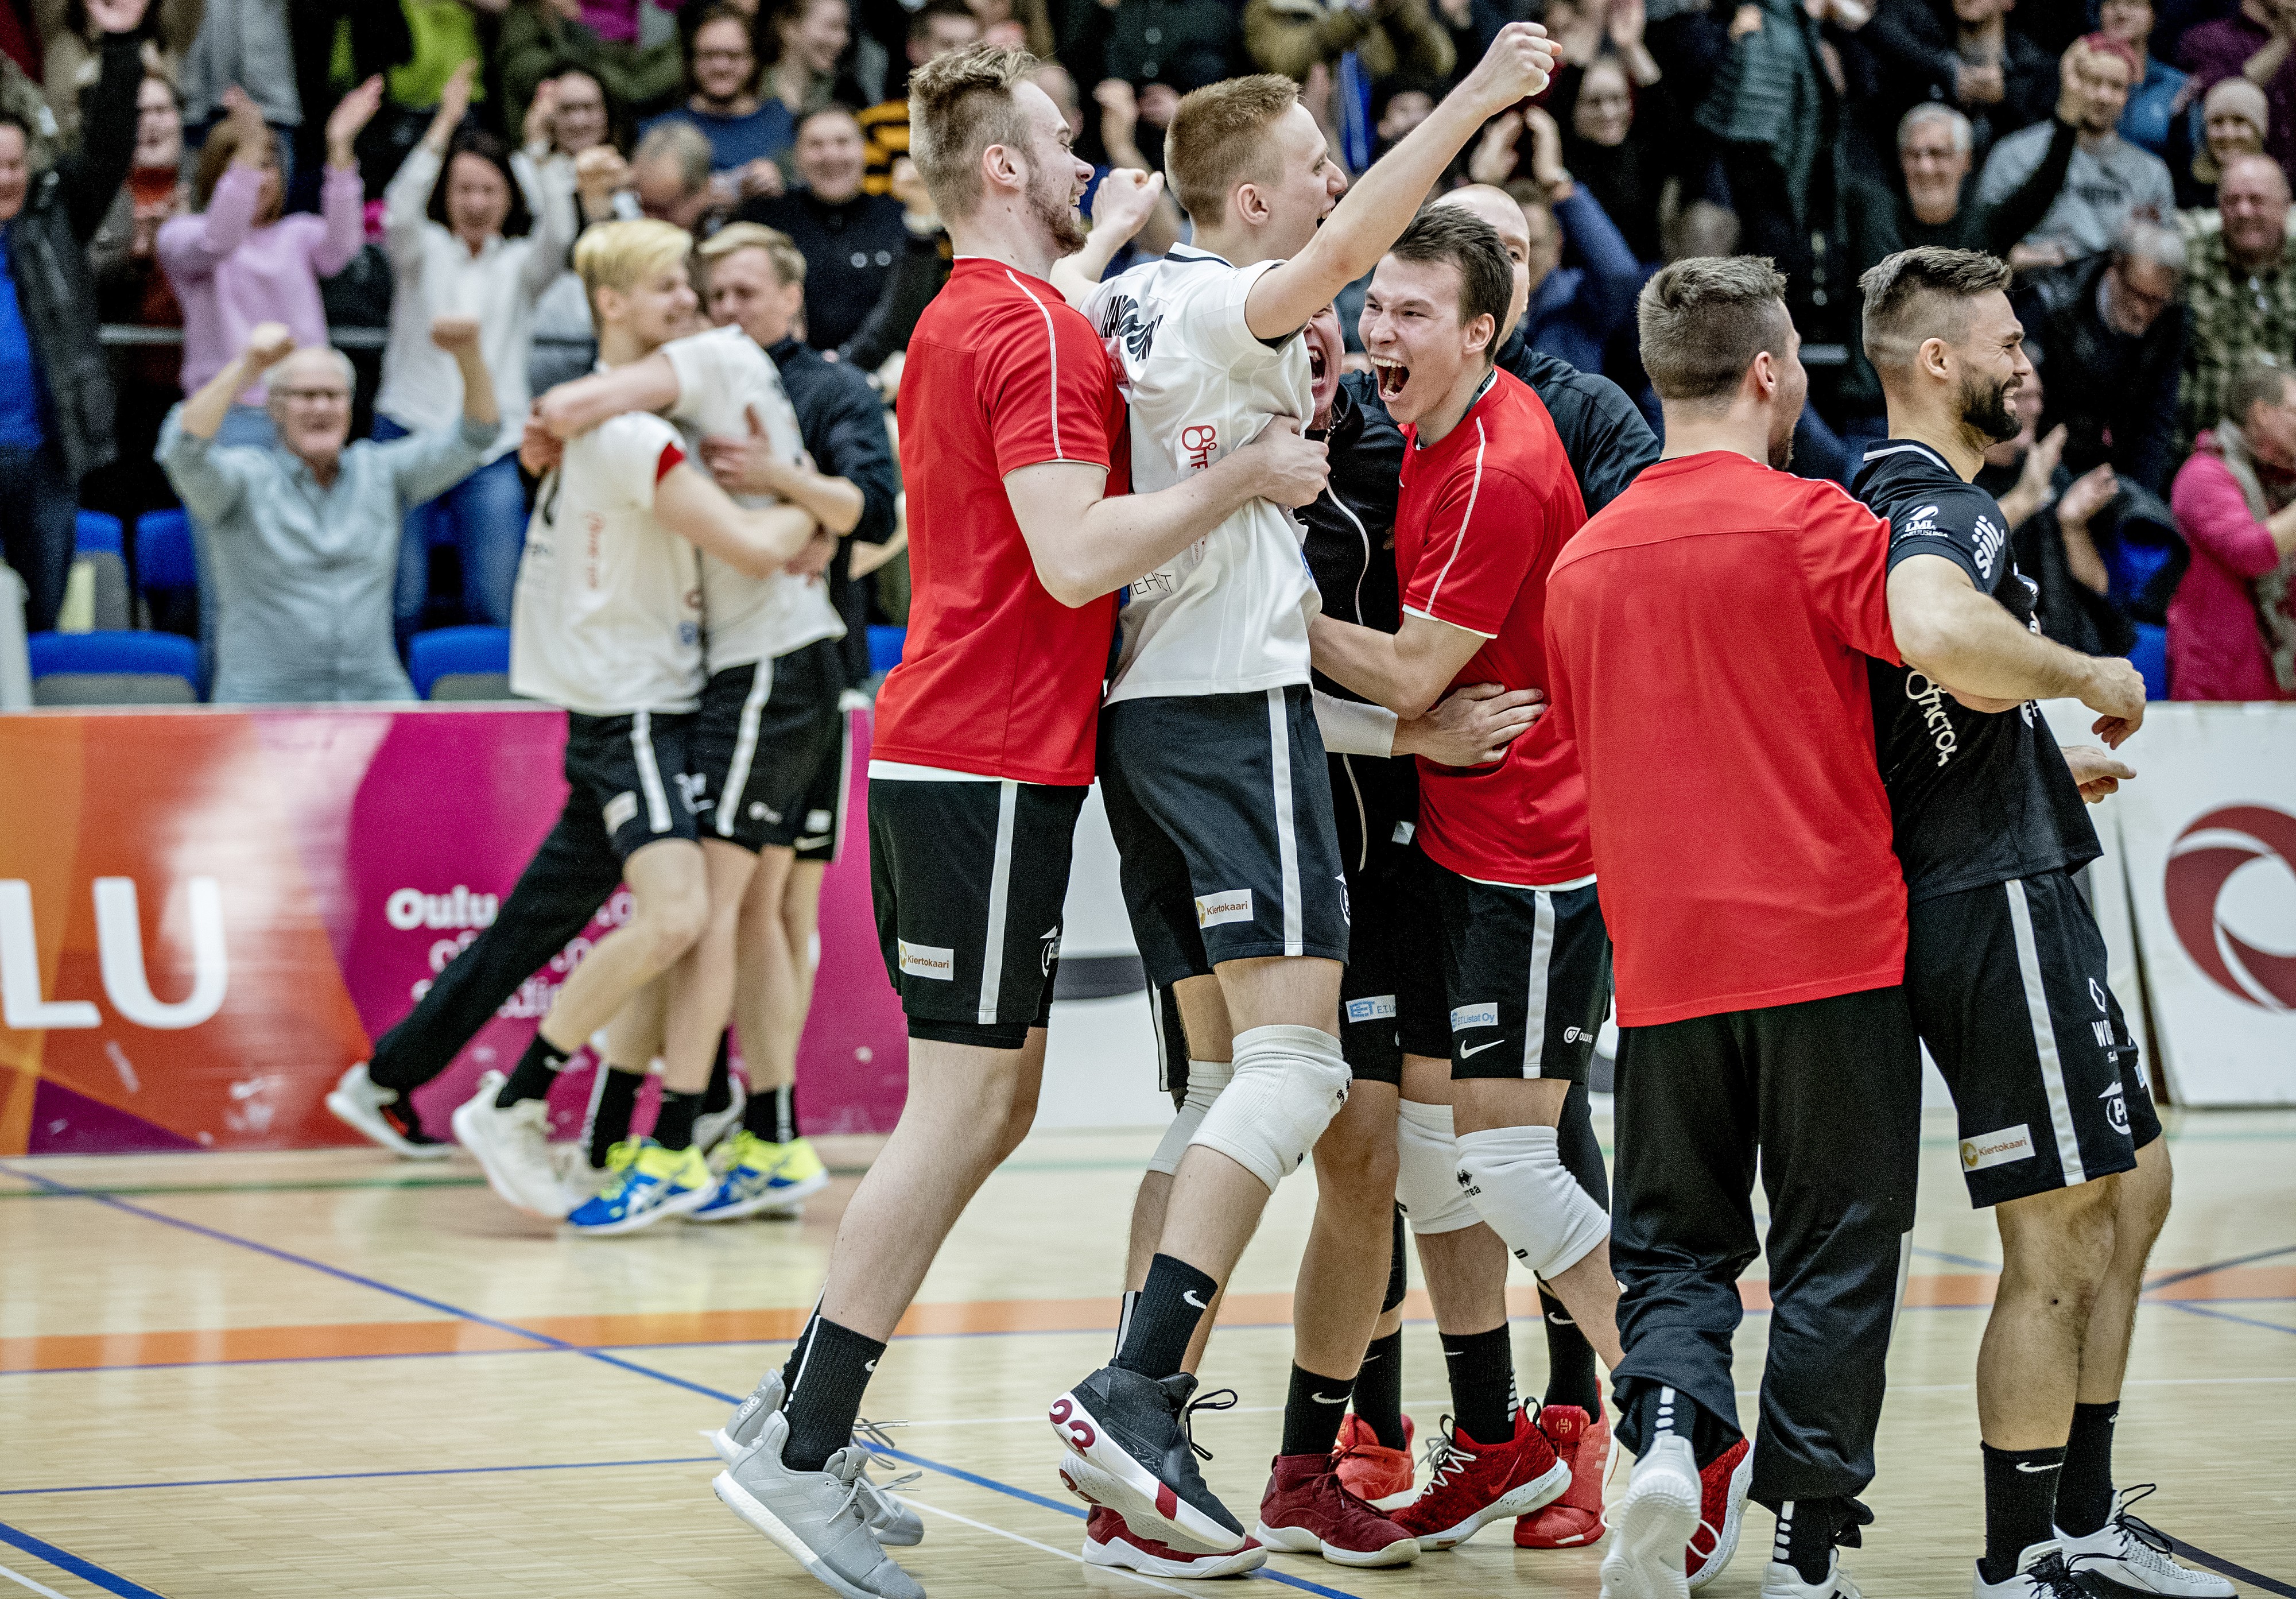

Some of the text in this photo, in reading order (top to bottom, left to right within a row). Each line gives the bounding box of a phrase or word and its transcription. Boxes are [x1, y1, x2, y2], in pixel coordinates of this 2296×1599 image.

[386, 884, 499, 930] Oulu
[1207, 900, 1248, 916] Kiertokaari
[0, 876, 228, 1029] LU
[907, 954, 949, 969] Kiertokaari
[1482, 1013, 1495, 1023] Oy
[1977, 1136, 2028, 1156] Kiertokaari
